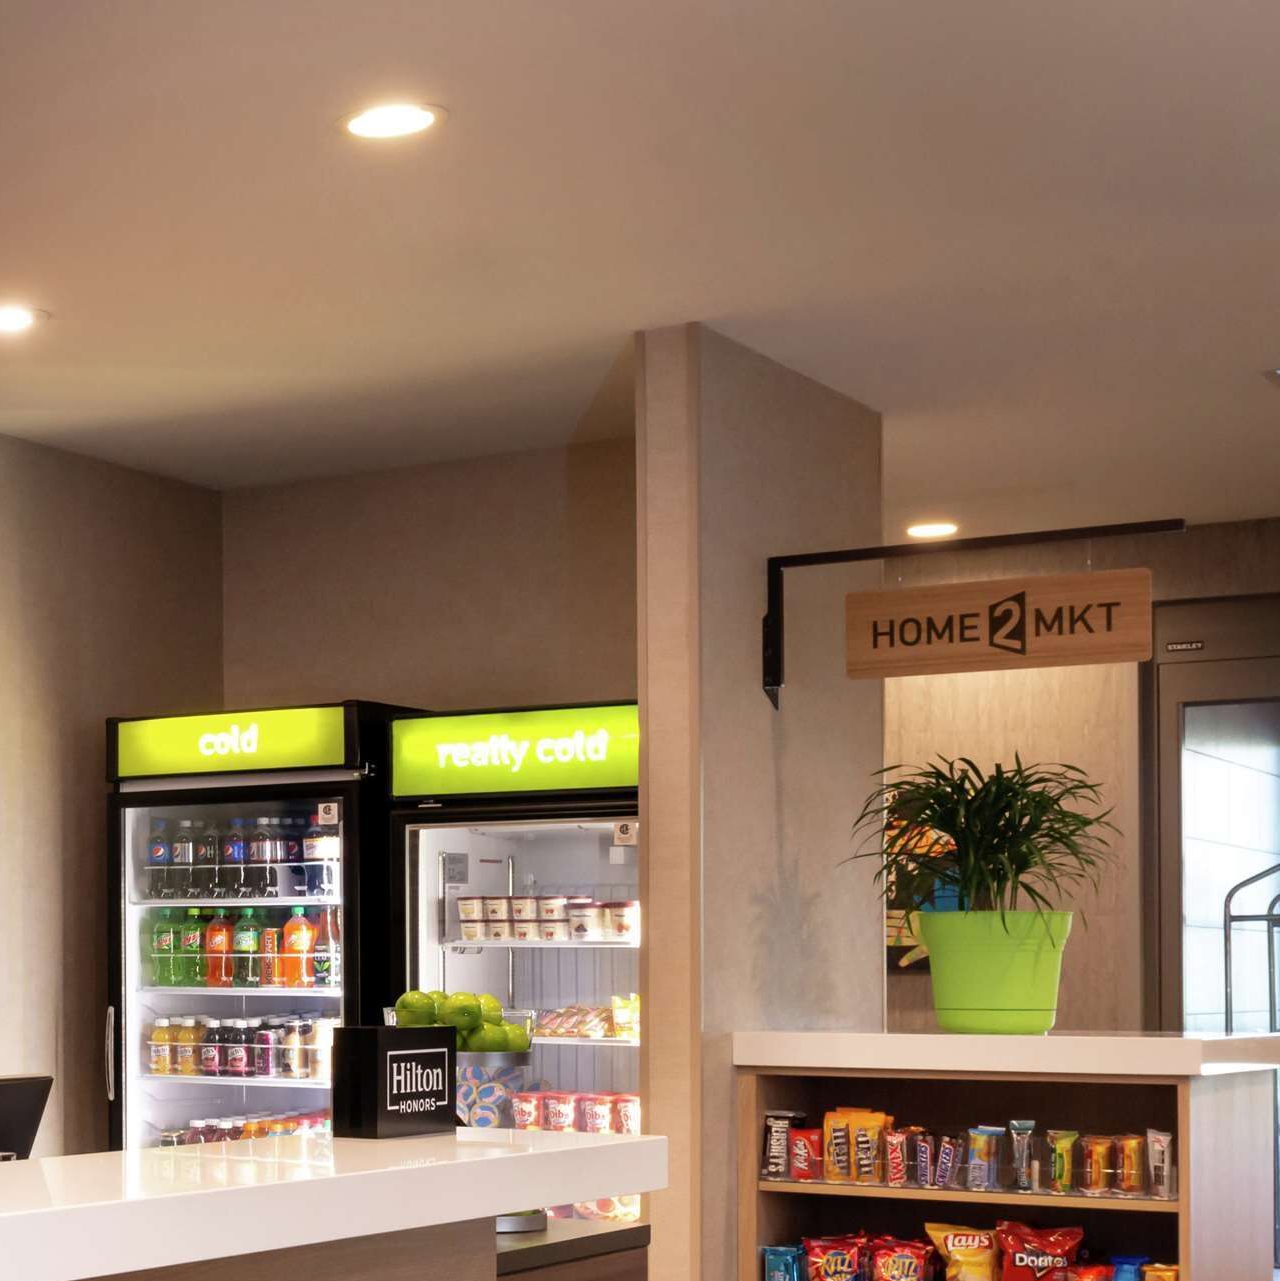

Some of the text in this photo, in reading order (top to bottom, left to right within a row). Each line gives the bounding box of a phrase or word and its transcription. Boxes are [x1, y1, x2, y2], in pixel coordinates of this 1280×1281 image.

[872, 600, 1122, 650] HOME 2 MKT
[199, 723, 258, 757] cold
[438, 728, 609, 773] really cold
[264, 935, 273, 983] KICKSART
[392, 1061, 444, 1094] Hilton
[400, 1098, 436, 1113] HONORS
[888, 1145, 903, 1182] TWIX
[919, 1144, 929, 1185] SNICKERS
[936, 1146, 953, 1185] SNICKERS
[820, 1253, 853, 1273] RITZ
[1015, 1252, 1068, 1267] Doritos
